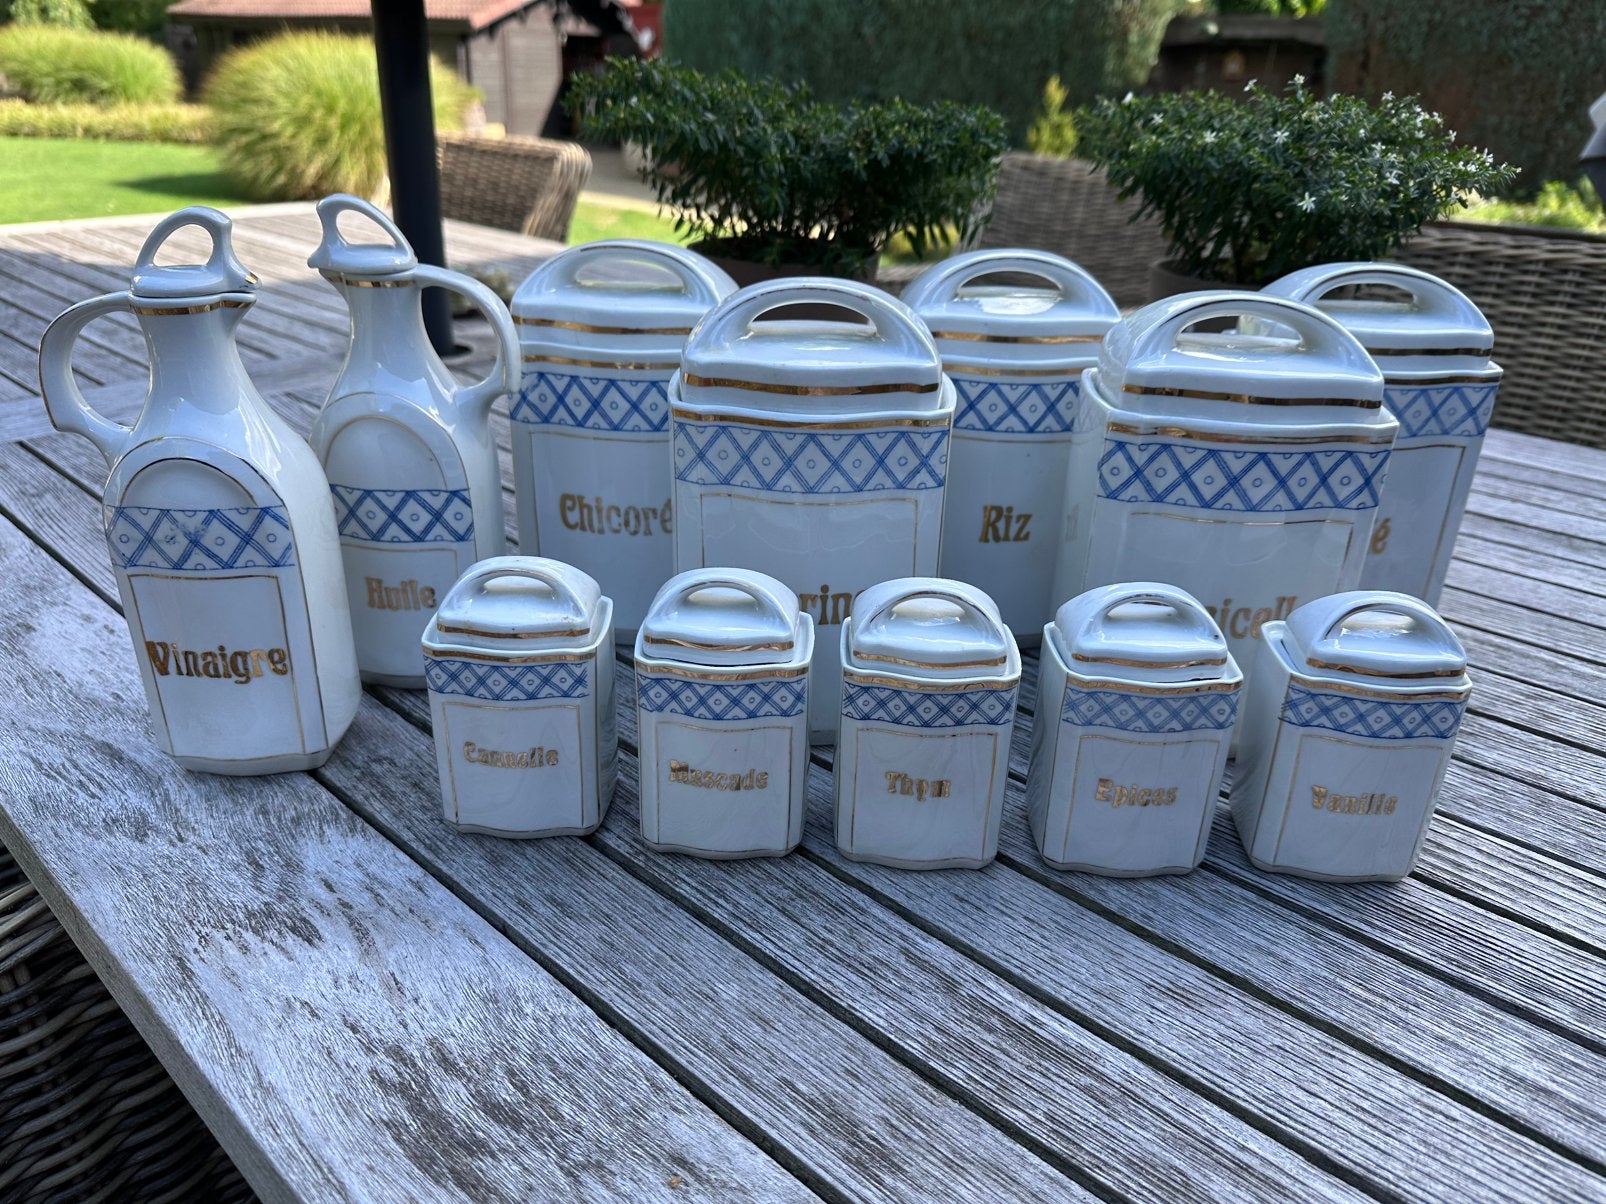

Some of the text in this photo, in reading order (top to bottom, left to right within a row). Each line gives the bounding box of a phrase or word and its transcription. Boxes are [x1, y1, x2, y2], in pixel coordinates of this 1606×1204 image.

[978, 504, 1033, 544] Riz
[364, 576, 437, 612] Huile
[799, 584, 864, 625] rin
[145, 640, 290, 685] Vinaigre
[669, 759, 769, 791] Muscade
[1094, 777, 1179, 808] Epices
[1311, 784, 1399, 816] Vanille
